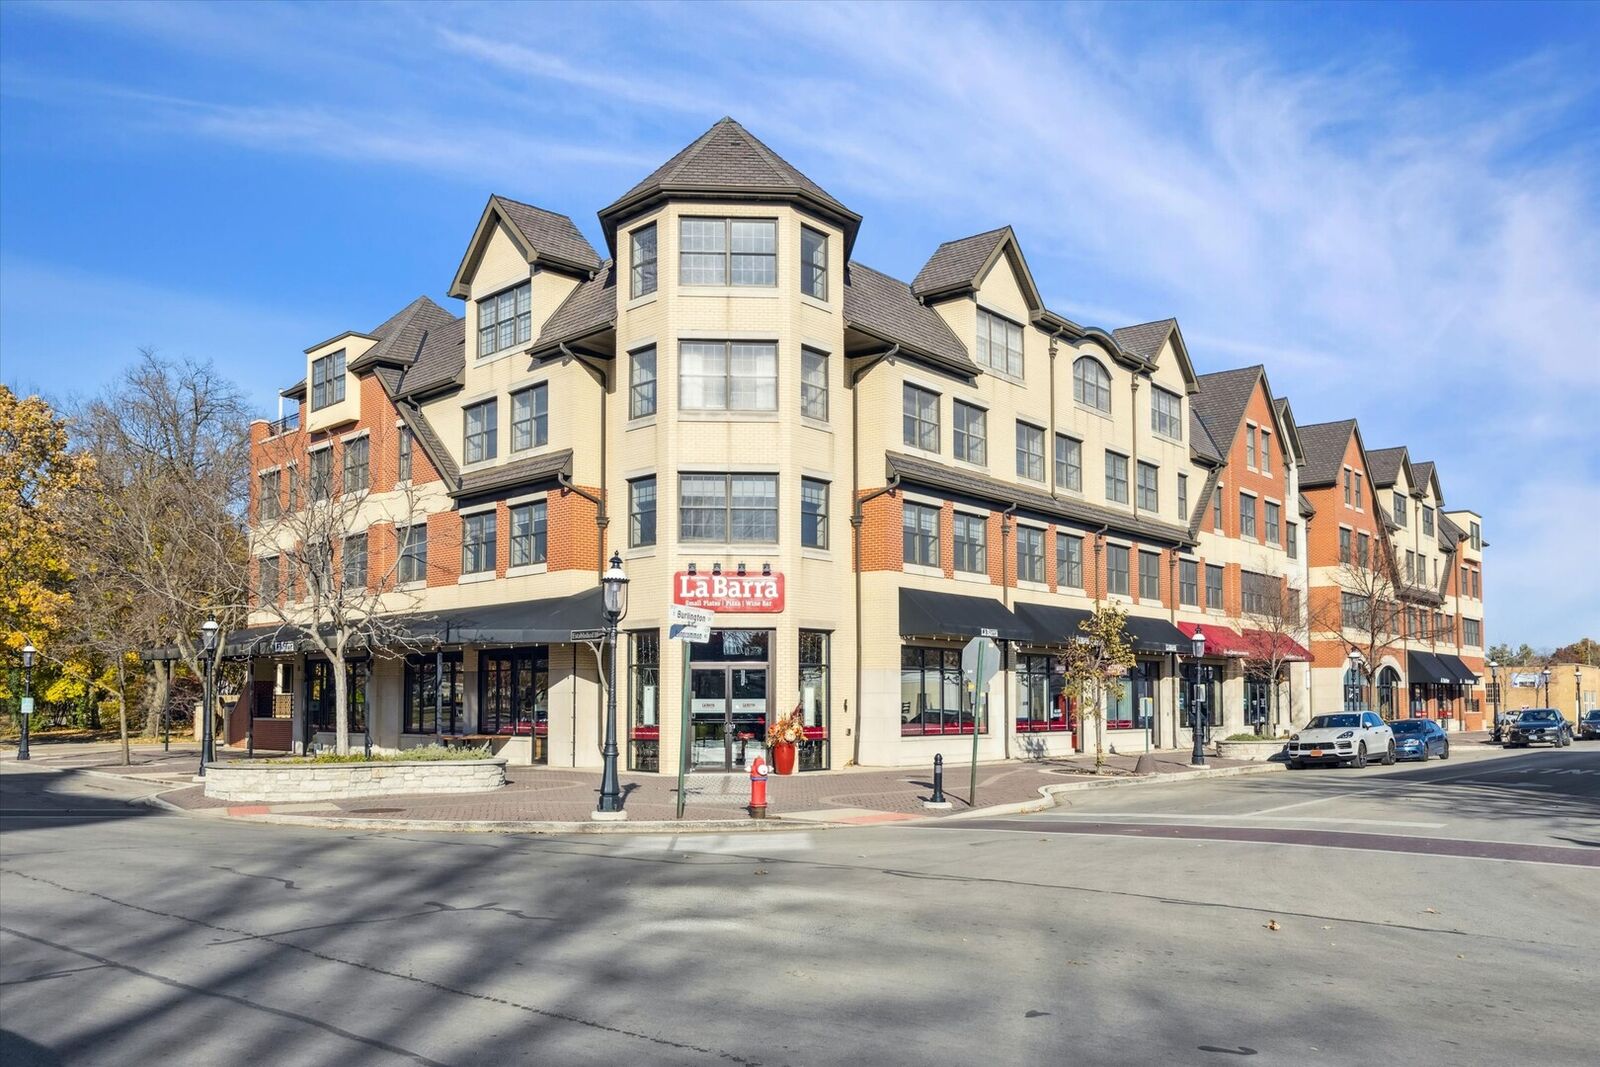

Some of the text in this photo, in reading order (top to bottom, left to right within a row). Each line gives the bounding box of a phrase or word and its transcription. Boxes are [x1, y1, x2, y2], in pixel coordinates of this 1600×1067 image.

[680, 575, 779, 598] La Barra
[677, 609, 706, 622] Burlington
